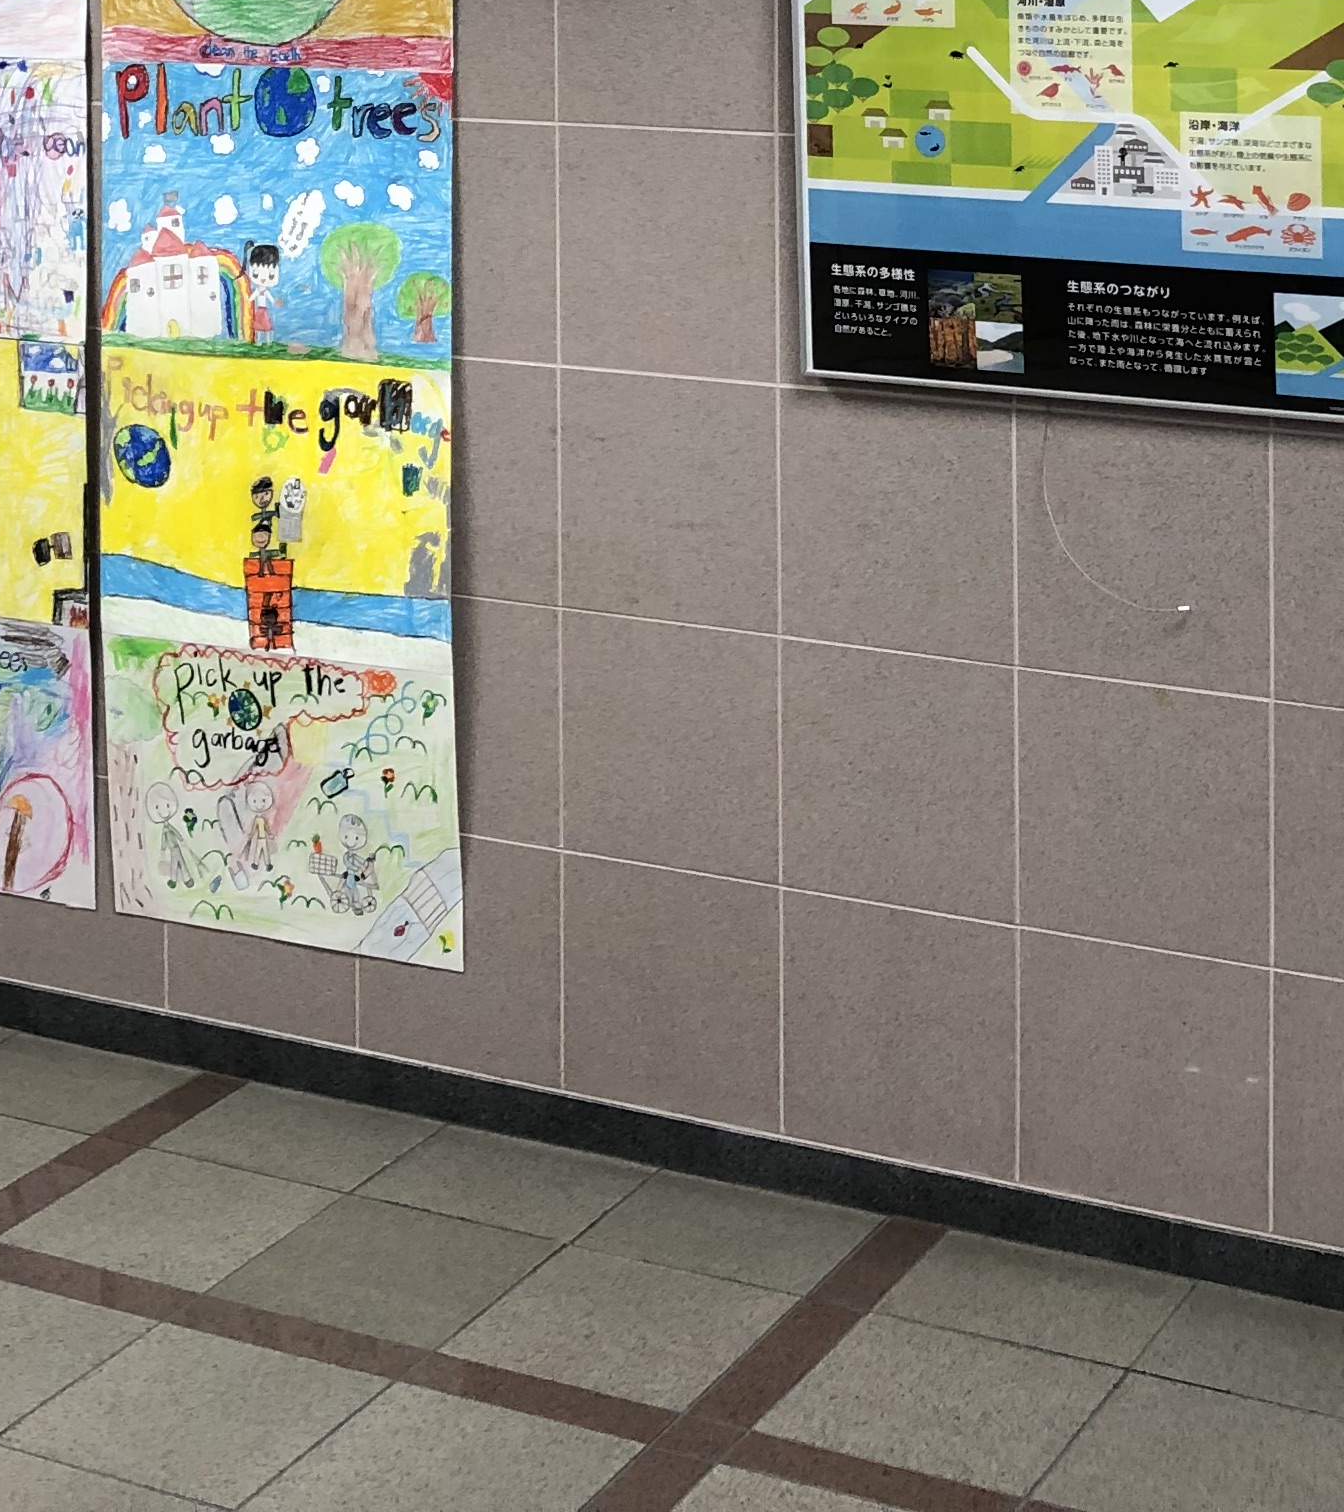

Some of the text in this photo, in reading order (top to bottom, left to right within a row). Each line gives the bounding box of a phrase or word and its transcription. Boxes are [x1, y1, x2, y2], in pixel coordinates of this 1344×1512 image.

[116, 62, 442, 142] Plant trees
[830, 263, 916, 282] 生態系の多様性
[1066, 280, 1171, 300] 生態系のつながり
[252, 666, 284, 707] up
[190, 726, 282, 769] garbage
